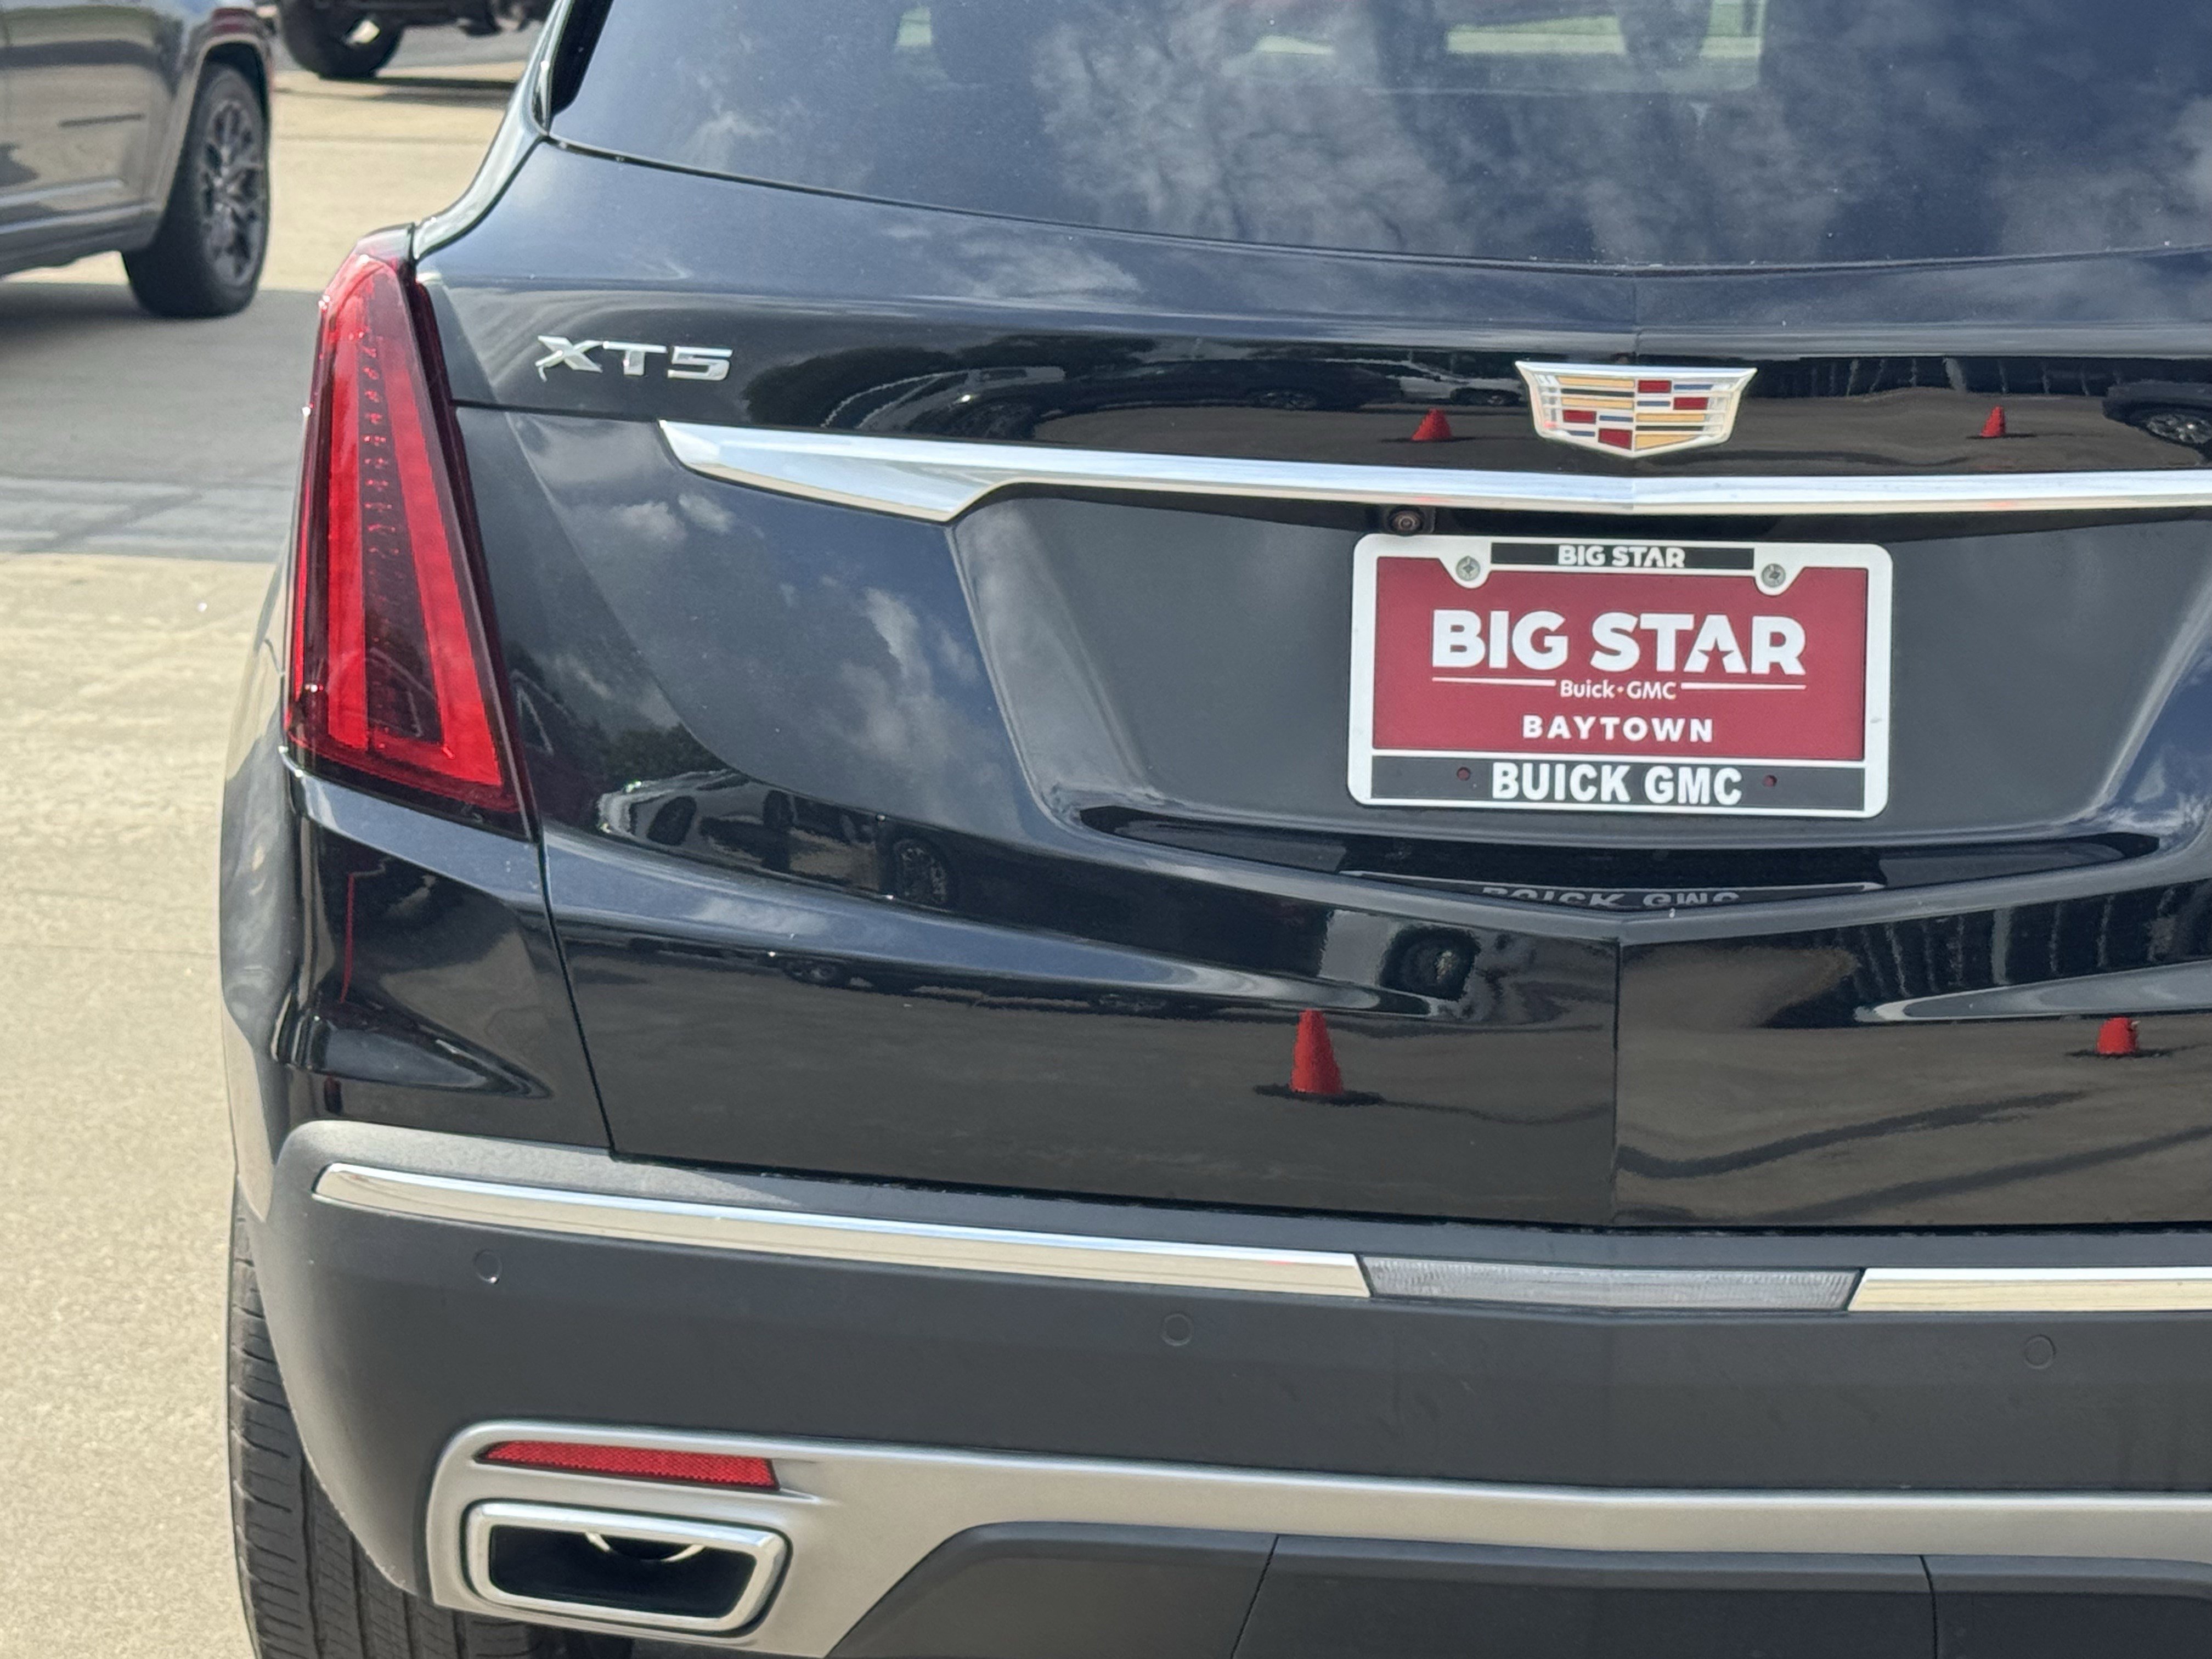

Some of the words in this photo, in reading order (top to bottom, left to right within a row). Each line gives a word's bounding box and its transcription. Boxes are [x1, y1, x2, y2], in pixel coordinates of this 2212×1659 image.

[535, 335, 733, 382] XT5
[1558, 545, 1605, 566] BIG
[1612, 546, 1685, 568] STAR
[1432, 609, 1568, 670] BIG
[1590, 612, 1806, 675] STAR
[1522, 715, 1713, 742] BAYTOWN
[1491, 763, 1630, 802] BUICK
[1645, 768, 1742, 805] GMC
